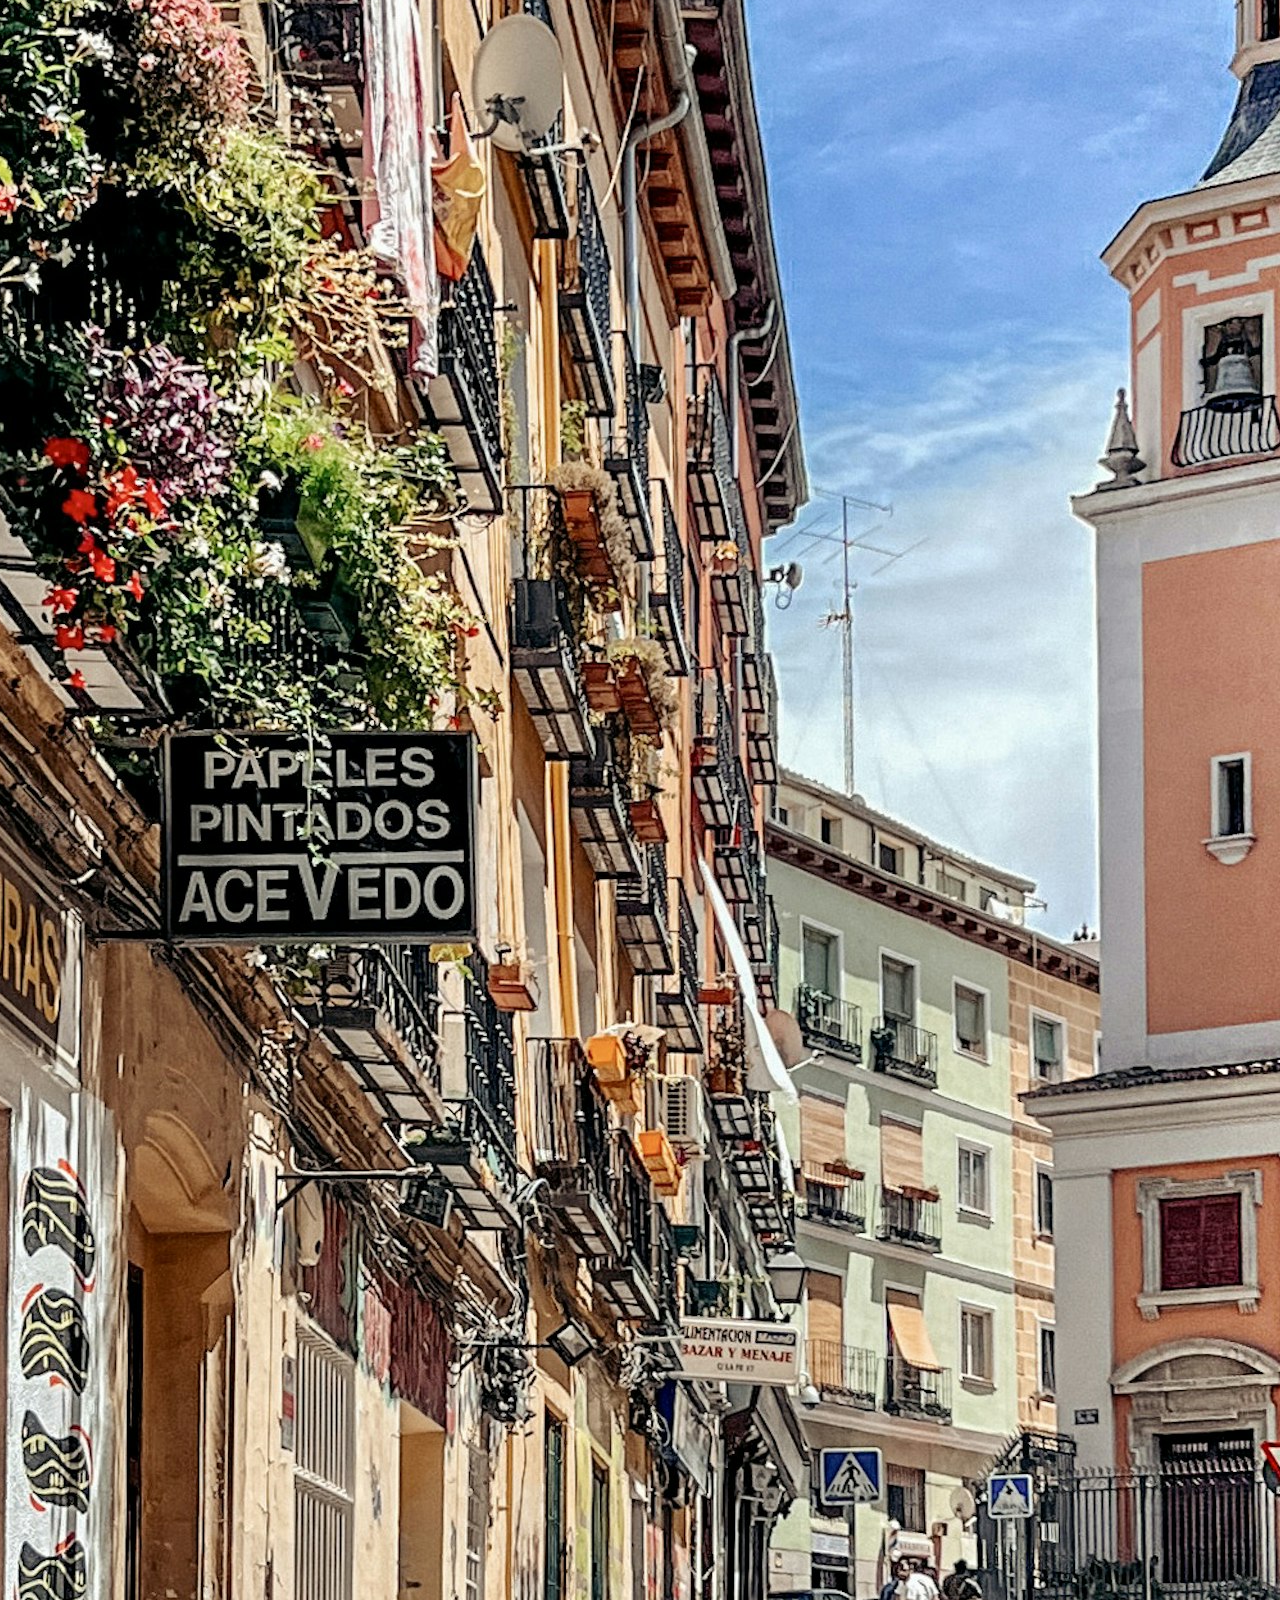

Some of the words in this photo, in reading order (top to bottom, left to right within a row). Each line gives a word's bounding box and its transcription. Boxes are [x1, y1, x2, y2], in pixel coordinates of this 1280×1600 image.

[203, 746, 436, 790] PAPELES
[189, 798, 451, 843] PINTADOS
[178, 862, 465, 923] ACEVEDO
[682, 1343, 723, 1358] BAZAR
[729, 1347, 737, 1359] Y
[741, 1349, 793, 1363] MENAJE
